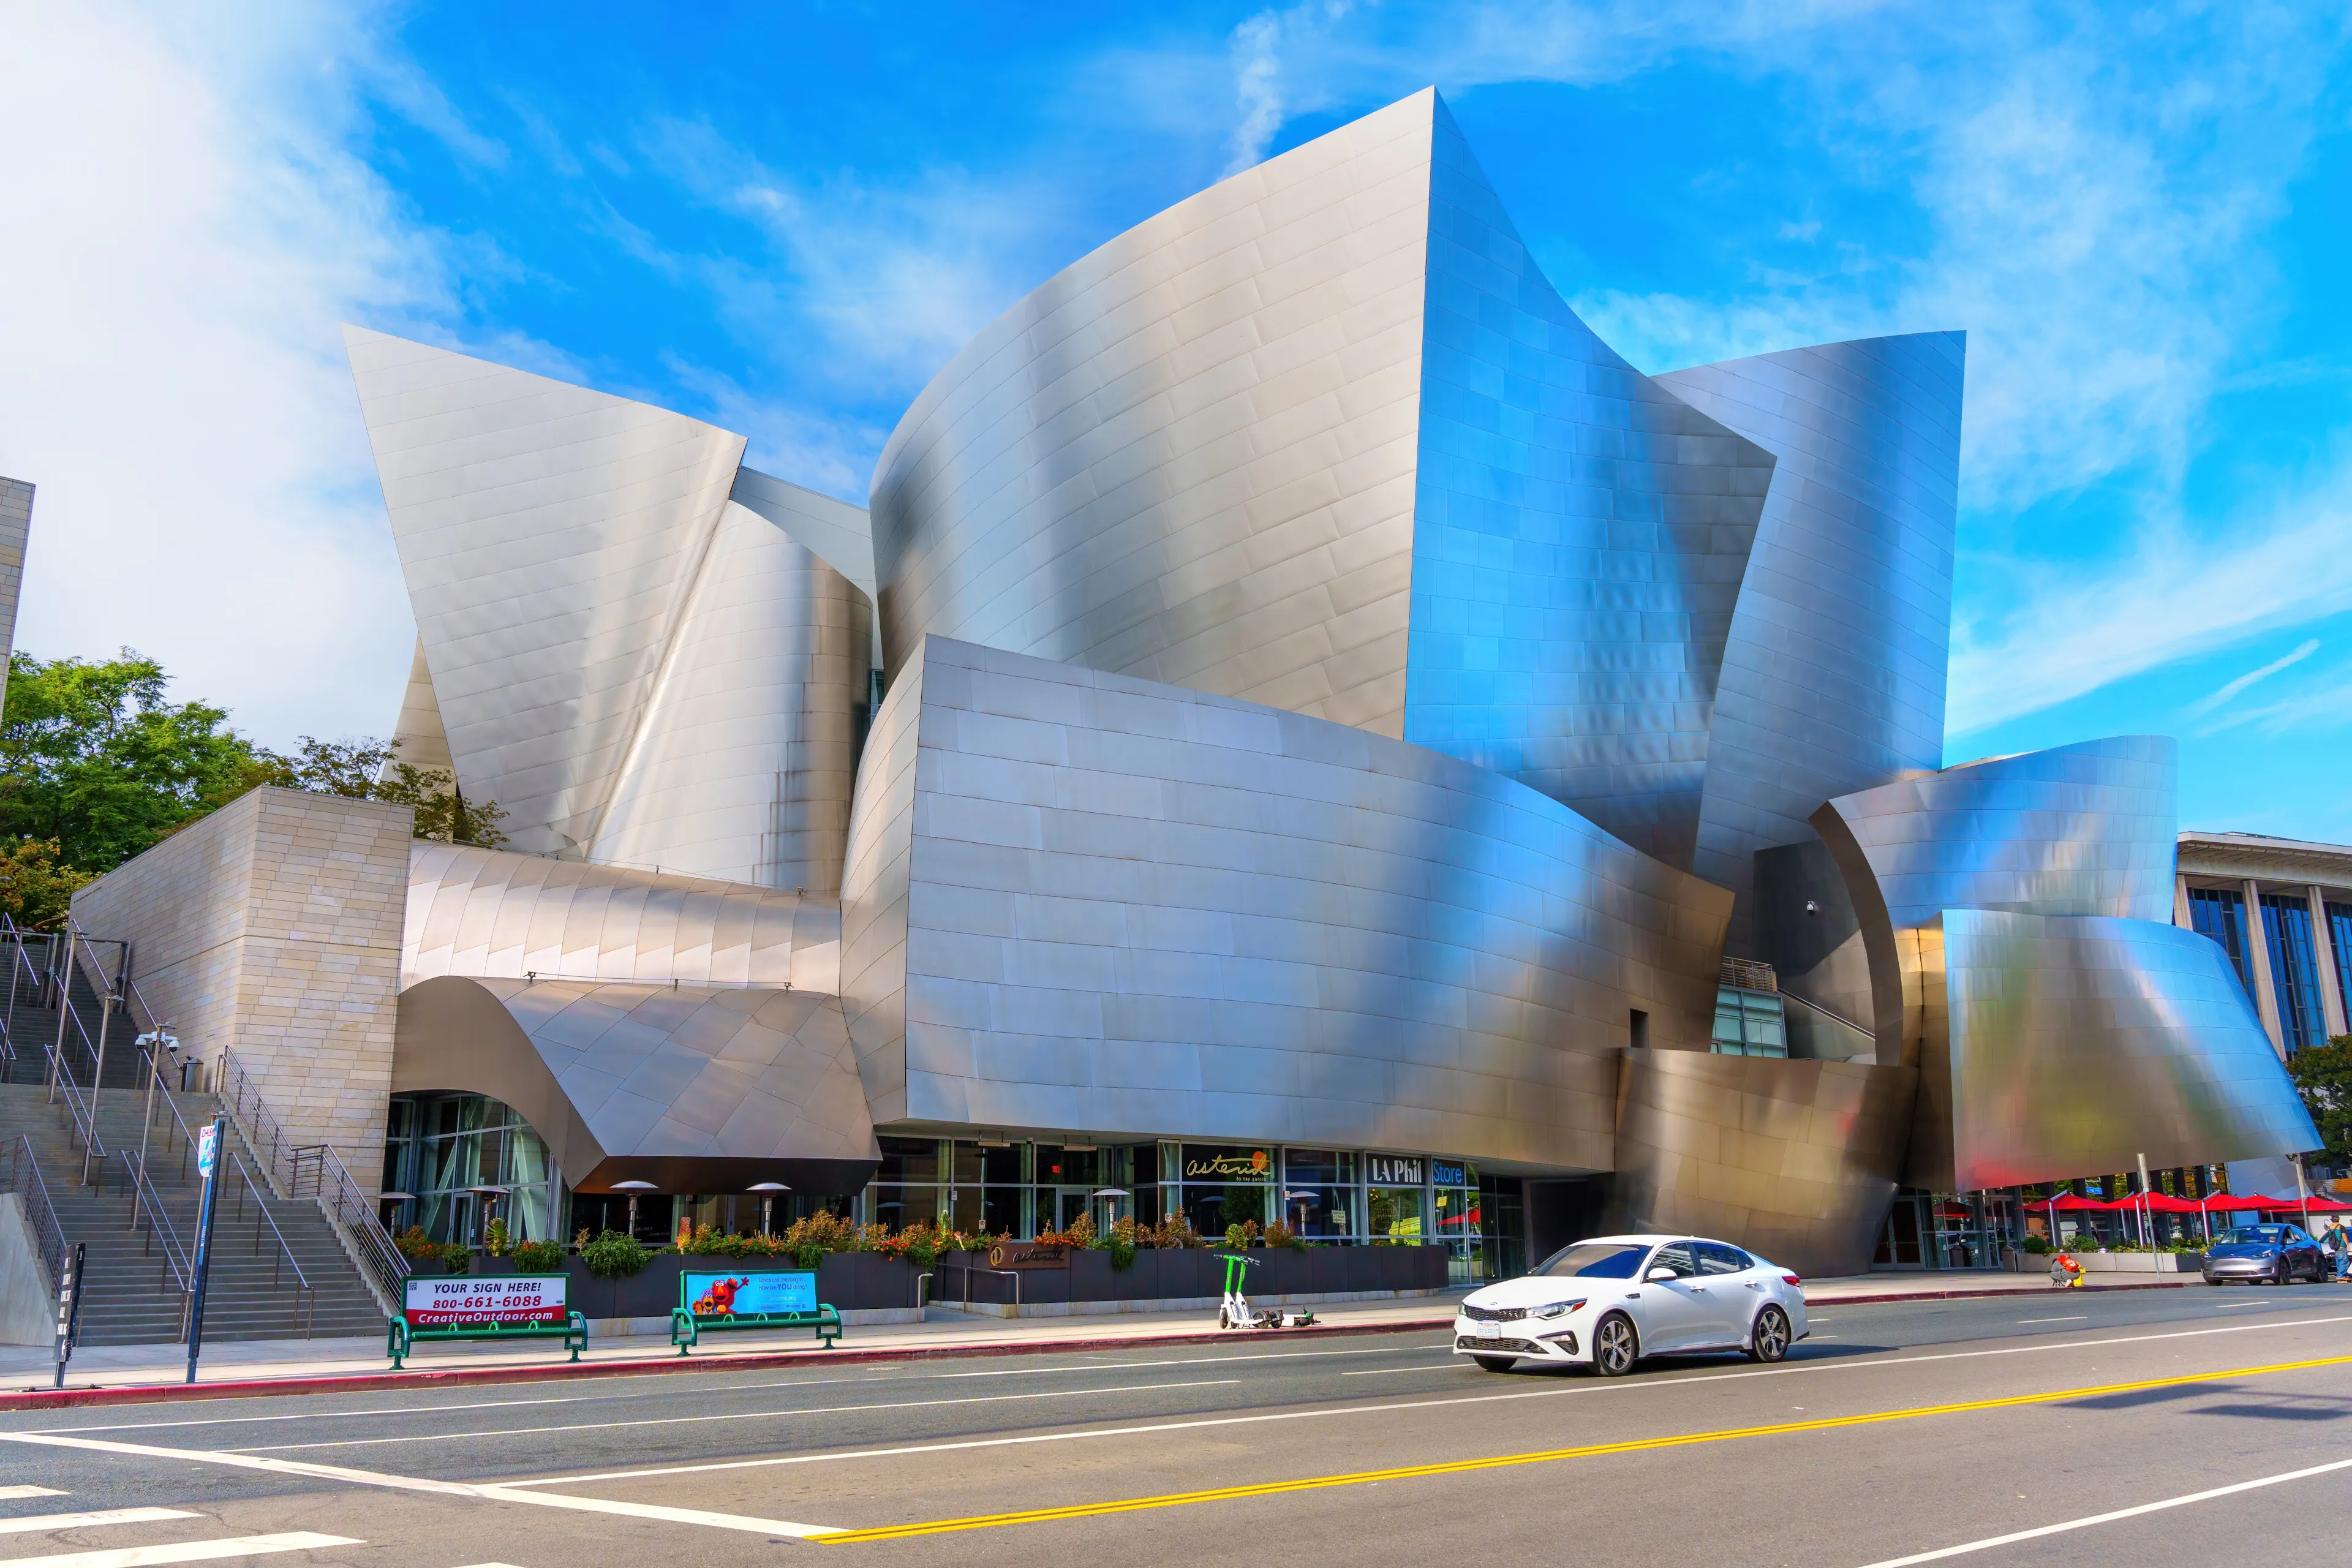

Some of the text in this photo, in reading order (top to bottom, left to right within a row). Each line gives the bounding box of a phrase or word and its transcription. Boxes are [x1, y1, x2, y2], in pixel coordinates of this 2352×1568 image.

[1187, 1154, 1271, 1176] asterid
[1373, 1159, 1422, 1183] LA Phil
[1433, 1161, 1462, 1183] Store
[434, 1282, 541, 1294] YOUR SIGN HERE!
[432, 1295, 542, 1309] 800-661-6088
[418, 1311, 553, 1324] CreativeOutdoor.com
